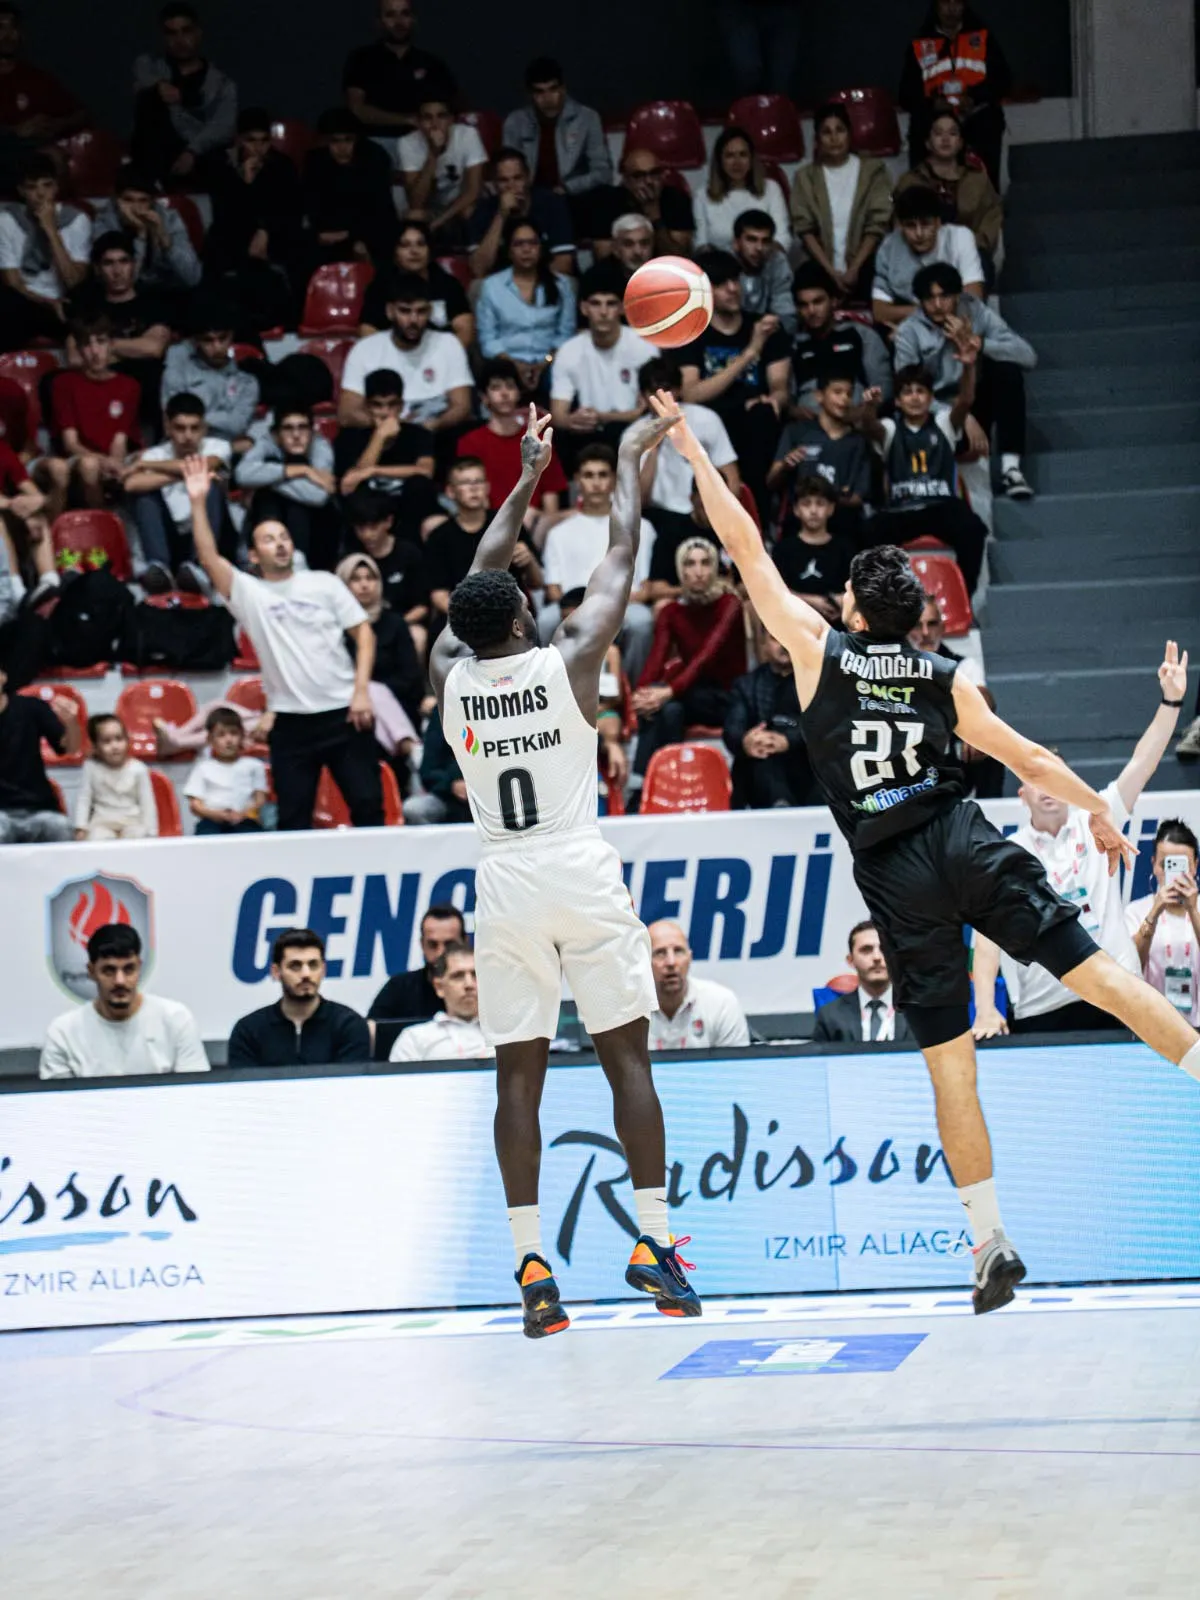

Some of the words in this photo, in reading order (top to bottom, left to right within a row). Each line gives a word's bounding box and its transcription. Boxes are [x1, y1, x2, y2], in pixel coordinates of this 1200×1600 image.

[460, 685, 549, 721] THOMAS
[850, 720, 925, 791] 27
[497, 766, 540, 832] 0
[622, 833, 834, 961] ERJİ
[765, 1235, 847, 1260] IZMIR
[859, 1229, 974, 1257] ALIAGA
[89, 1264, 205, 1292] ALIAGA
